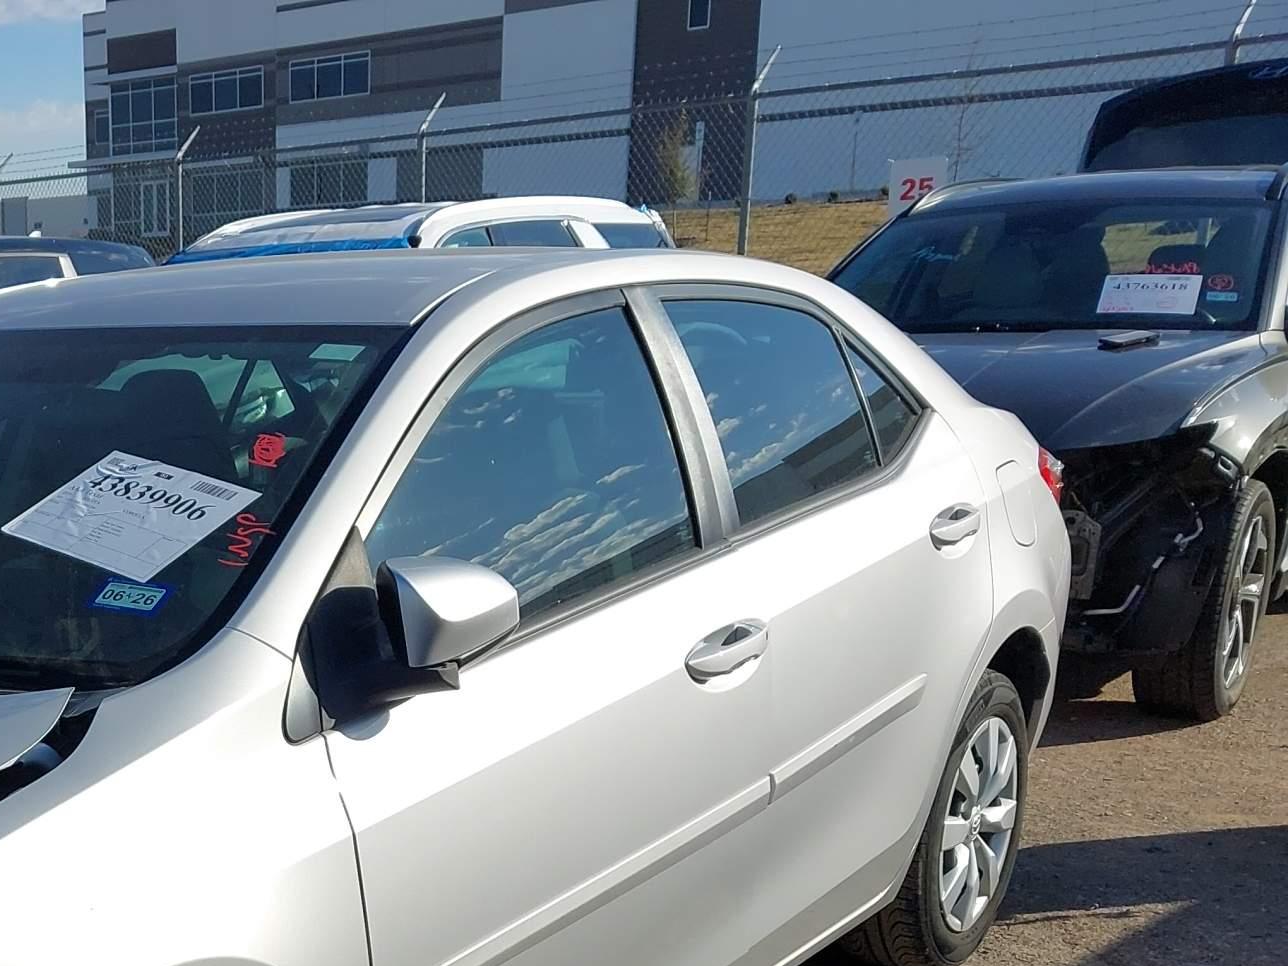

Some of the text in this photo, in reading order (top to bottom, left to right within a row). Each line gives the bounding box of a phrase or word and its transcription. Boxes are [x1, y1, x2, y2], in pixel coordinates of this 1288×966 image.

[899, 176, 934, 202] 25
[89, 473, 216, 521] 43839906
[102, 588, 158, 606] 06 26
